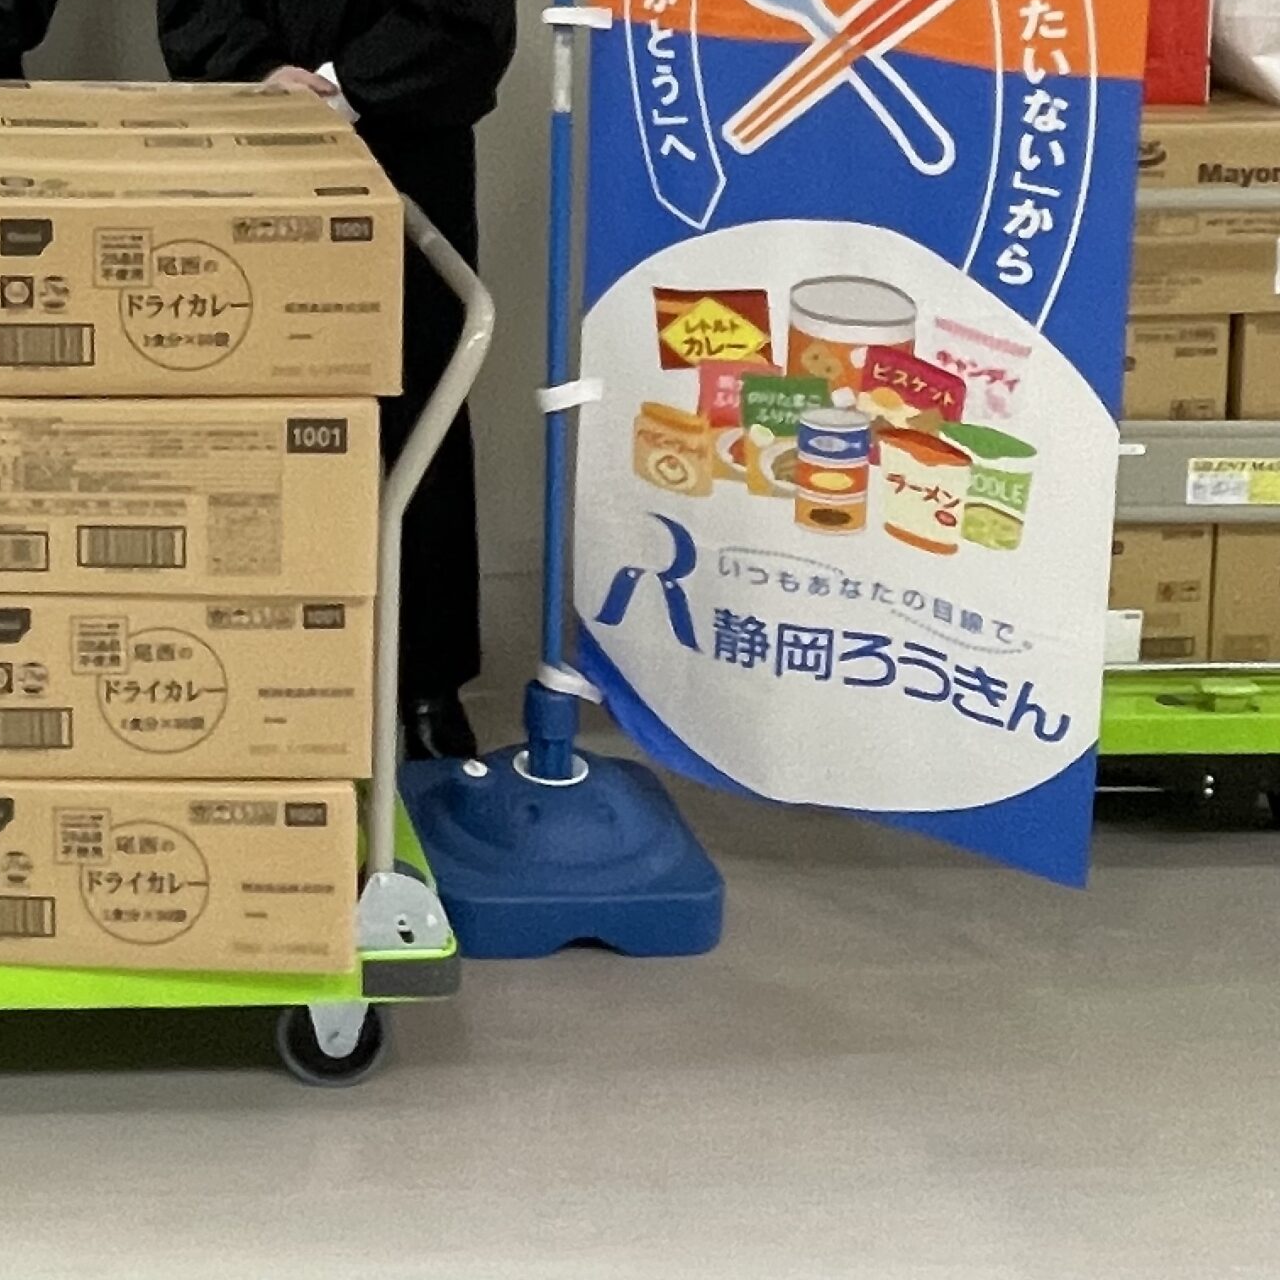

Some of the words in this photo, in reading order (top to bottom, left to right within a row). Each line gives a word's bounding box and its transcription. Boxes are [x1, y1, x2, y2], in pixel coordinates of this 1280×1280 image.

[127, 293, 249, 319] ドライカレー
[684, 318, 740, 334] レトルト
[682, 336, 748, 357] カレー
[292, 426, 342, 449] 1001
[886, 472, 961, 509] ラーメン
[720, 556, 1033, 650] いつもあなたの目線で。
[713, 606, 1071, 742] 静岡ろうきん
[104, 679, 227, 704] ドライカレー
[88, 870, 209, 895] ドライカレー
